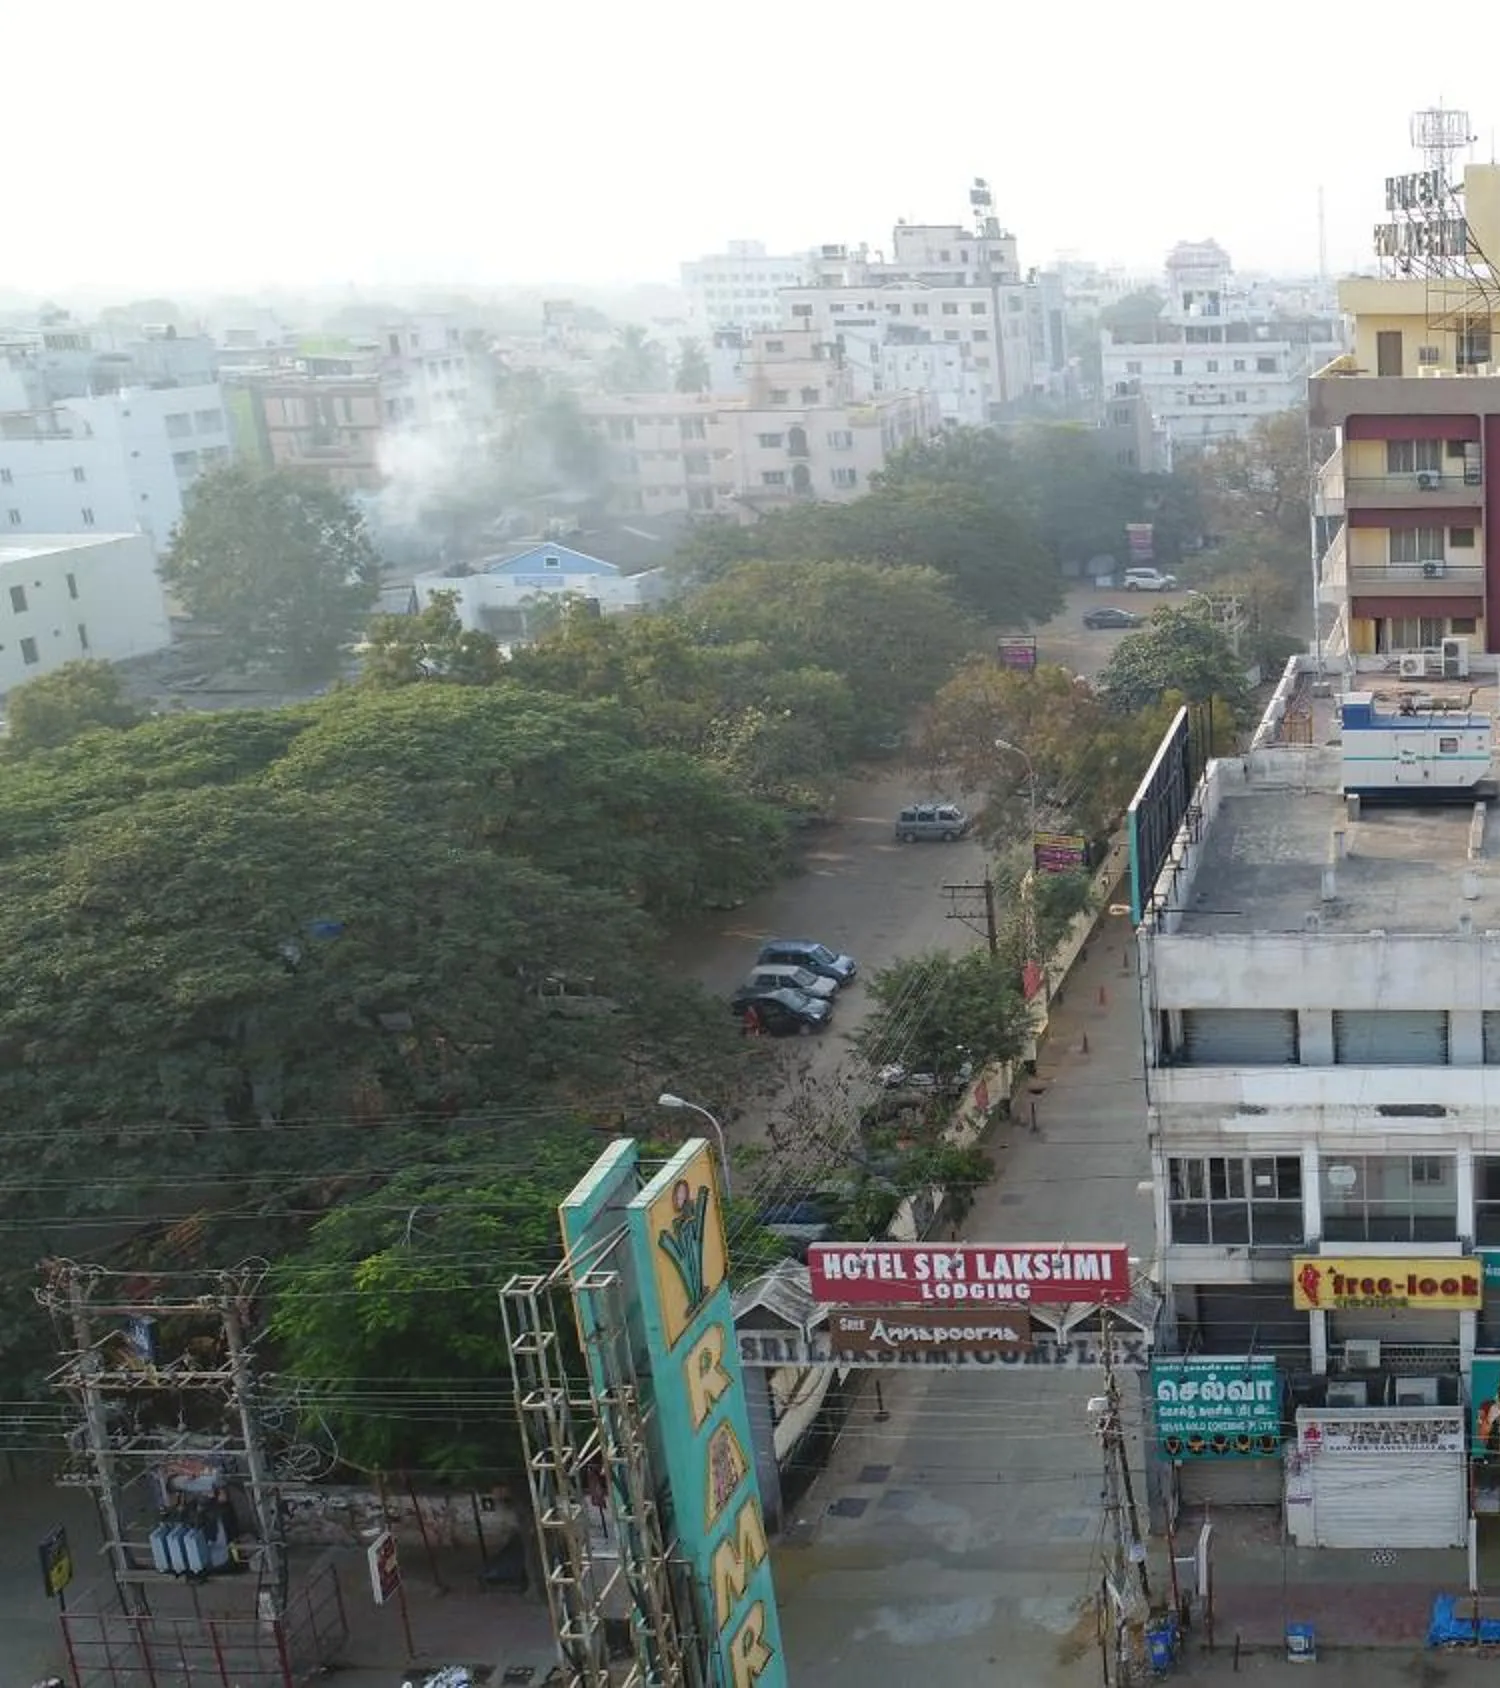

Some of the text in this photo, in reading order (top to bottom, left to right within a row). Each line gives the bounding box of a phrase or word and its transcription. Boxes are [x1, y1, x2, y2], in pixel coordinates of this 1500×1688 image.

[823, 1253, 1113, 1280] HOTEL SRI LAKSHMI
[922, 1283, 1032, 1299] LODGING
[1332, 1274, 1479, 1297] free-look
[870, 1319, 1020, 1346] Annapoorna
[1156, 1373, 1275, 1402] செல்வா
